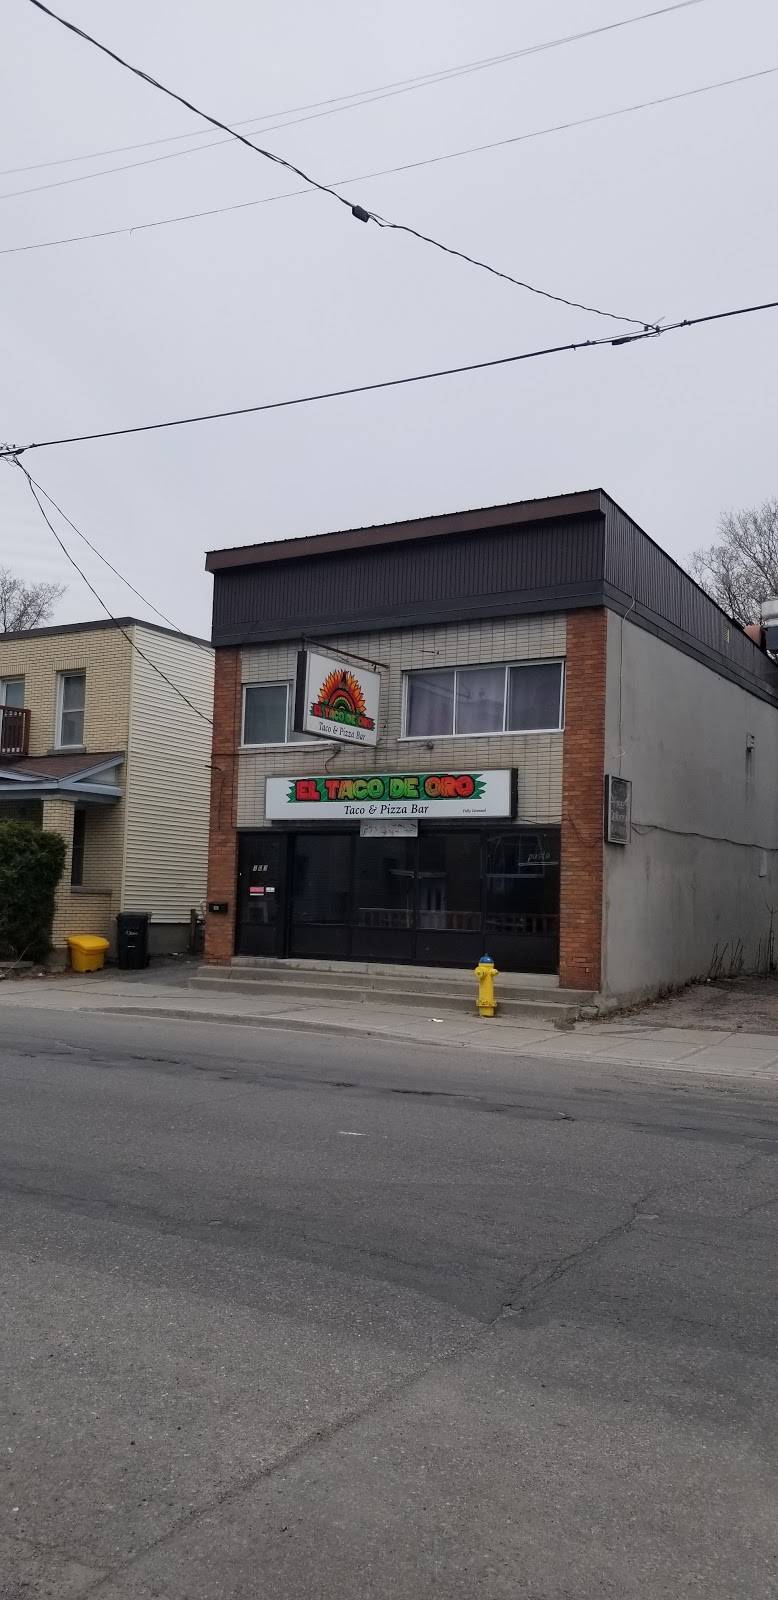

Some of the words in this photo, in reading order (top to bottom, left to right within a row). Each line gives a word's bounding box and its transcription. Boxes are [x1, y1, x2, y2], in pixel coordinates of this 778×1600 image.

[319, 722, 332, 732] Taco
[340, 726, 355, 738] Pizza
[356, 731, 366, 740] Bar
[296, 780, 321, 801] EL
[325, 778, 385, 800] TACO
[389, 777, 419, 799] DE
[424, 774, 475, 798] ORO
[344, 805, 365, 814] Taco
[368, 804, 377, 814] &
[380, 803, 407, 815] Pizza
[411, 804, 429, 814] Bar
